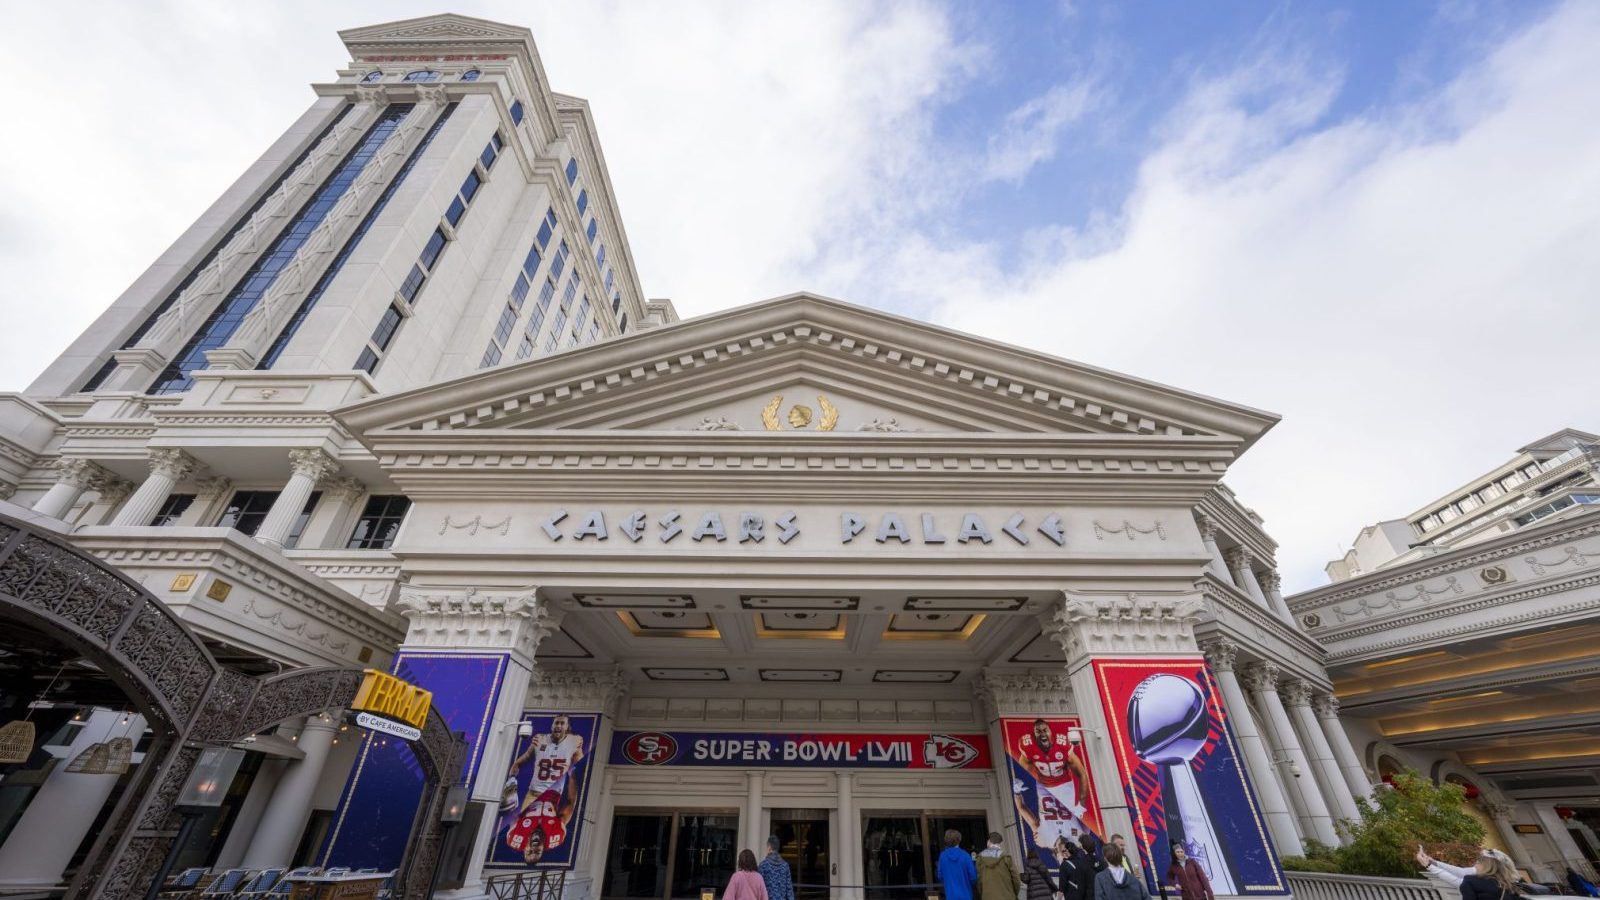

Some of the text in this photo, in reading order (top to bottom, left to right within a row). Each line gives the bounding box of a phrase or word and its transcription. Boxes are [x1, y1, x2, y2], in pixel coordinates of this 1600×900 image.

[541, 508, 1065, 547] CAESARS PALACE
[351, 668, 432, 730] TERRAZA
[360, 715, 369, 723] BY
[387, 723, 418, 738] AMERICANO
[693, 739, 912, 762] SUPER BOWL LVIII
[538, 758, 567, 781] 85
[1035, 761, 1064, 777] 95
